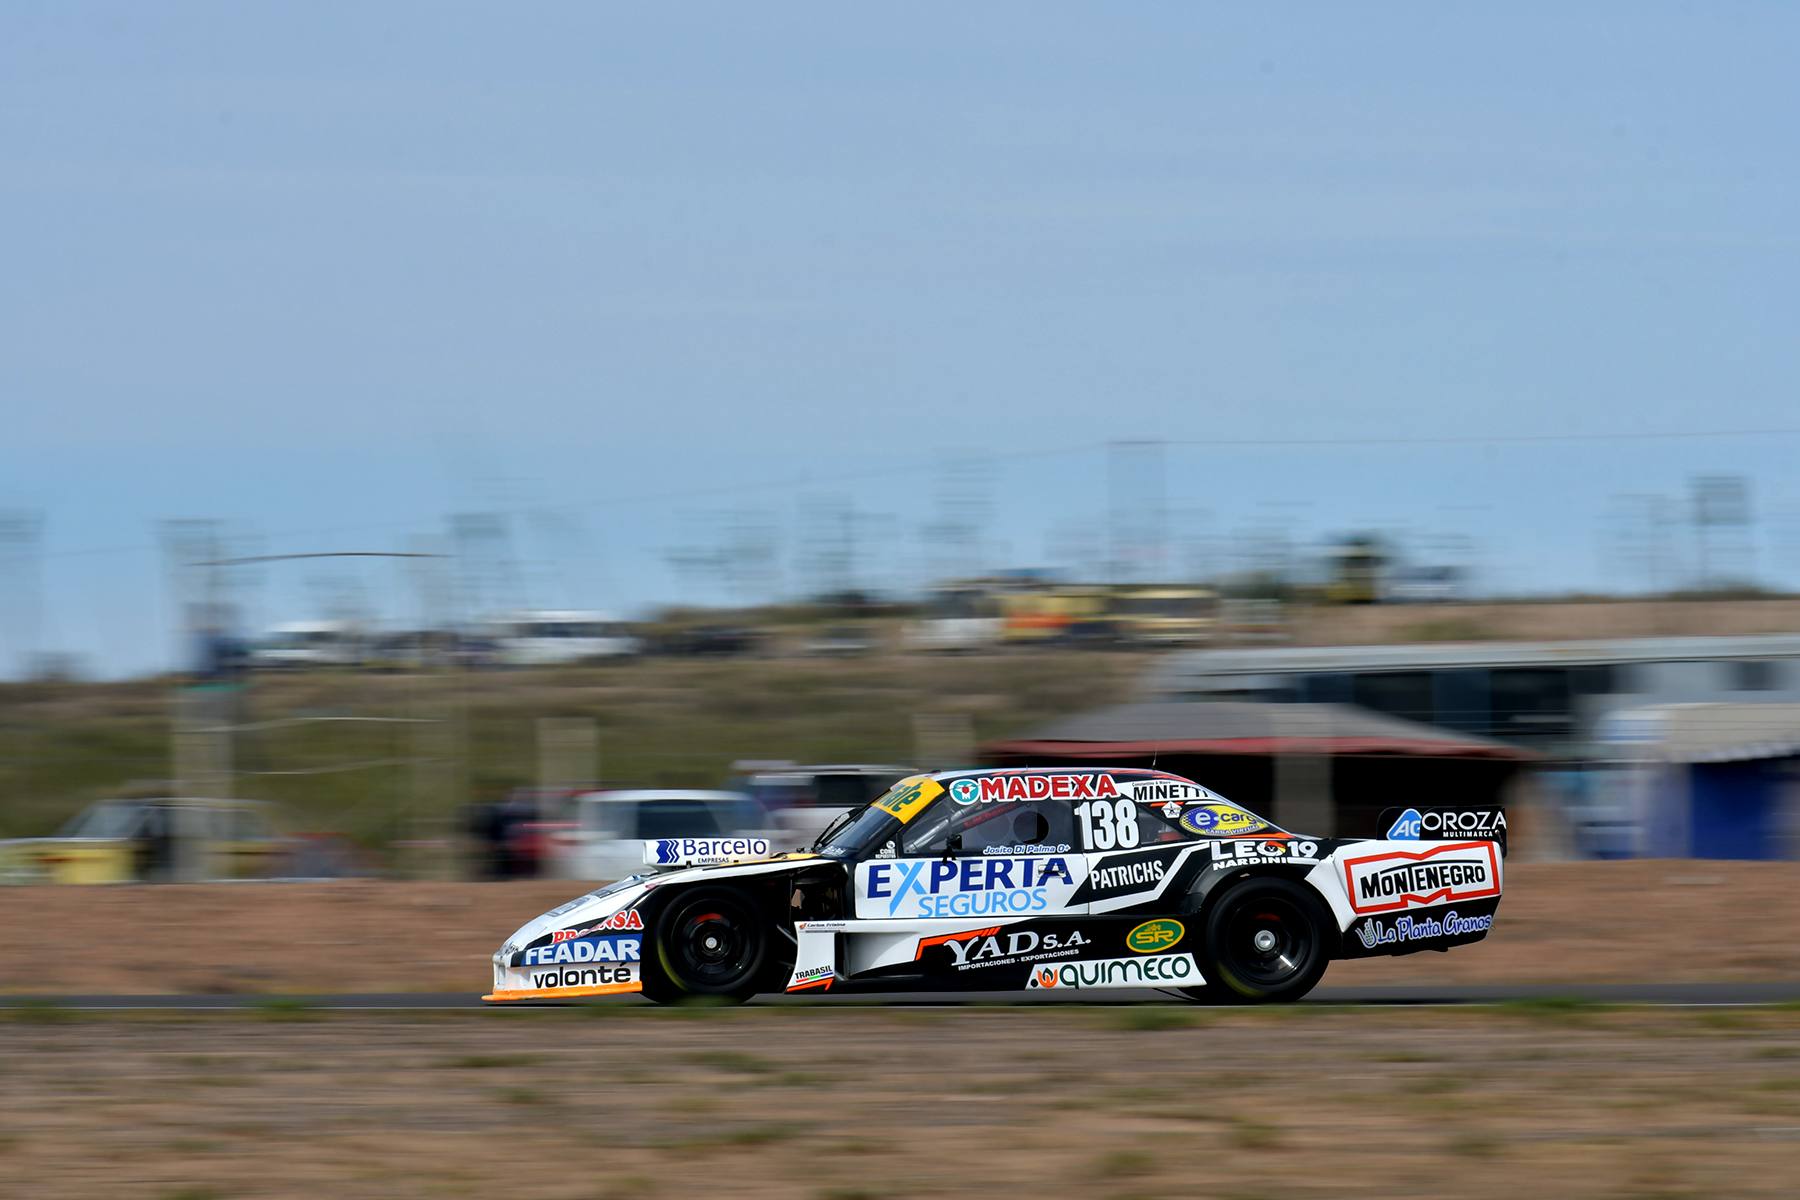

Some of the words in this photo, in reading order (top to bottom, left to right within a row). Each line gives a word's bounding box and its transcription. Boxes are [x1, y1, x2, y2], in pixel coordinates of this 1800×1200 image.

[980, 774, 1118, 801] MADEXA
[1074, 801, 1139, 850] 138
[1422, 811, 1507, 831] OROZA
[683, 839, 767, 856] Barcelo
[1014, 845, 1025, 854] Di
[1026, 845, 1056, 854] Palma
[1088, 859, 1164, 890] PATRICHS
[1212, 857, 1287, 871] NARDINI
[867, 858, 1073, 917] EXPERTA
[1360, 860, 1486, 899] MONTENEGRO
[918, 888, 1047, 919] SEGUROS
[1135, 930, 1174, 944] SR
[1376, 921, 1396, 944] La
[1396, 915, 1442, 942] Planta
[1443, 910, 1493, 936] Granos
[525, 939, 641, 965] FEADAR
[944, 931, 1040, 966] YAD
[958, 957, 1015, 971] IMPORTACIONES
[1020, 949, 1080, 962] EXPORTACIONES
[534, 962, 631, 988] volonté
[795, 965, 833, 979] TRABASIL
